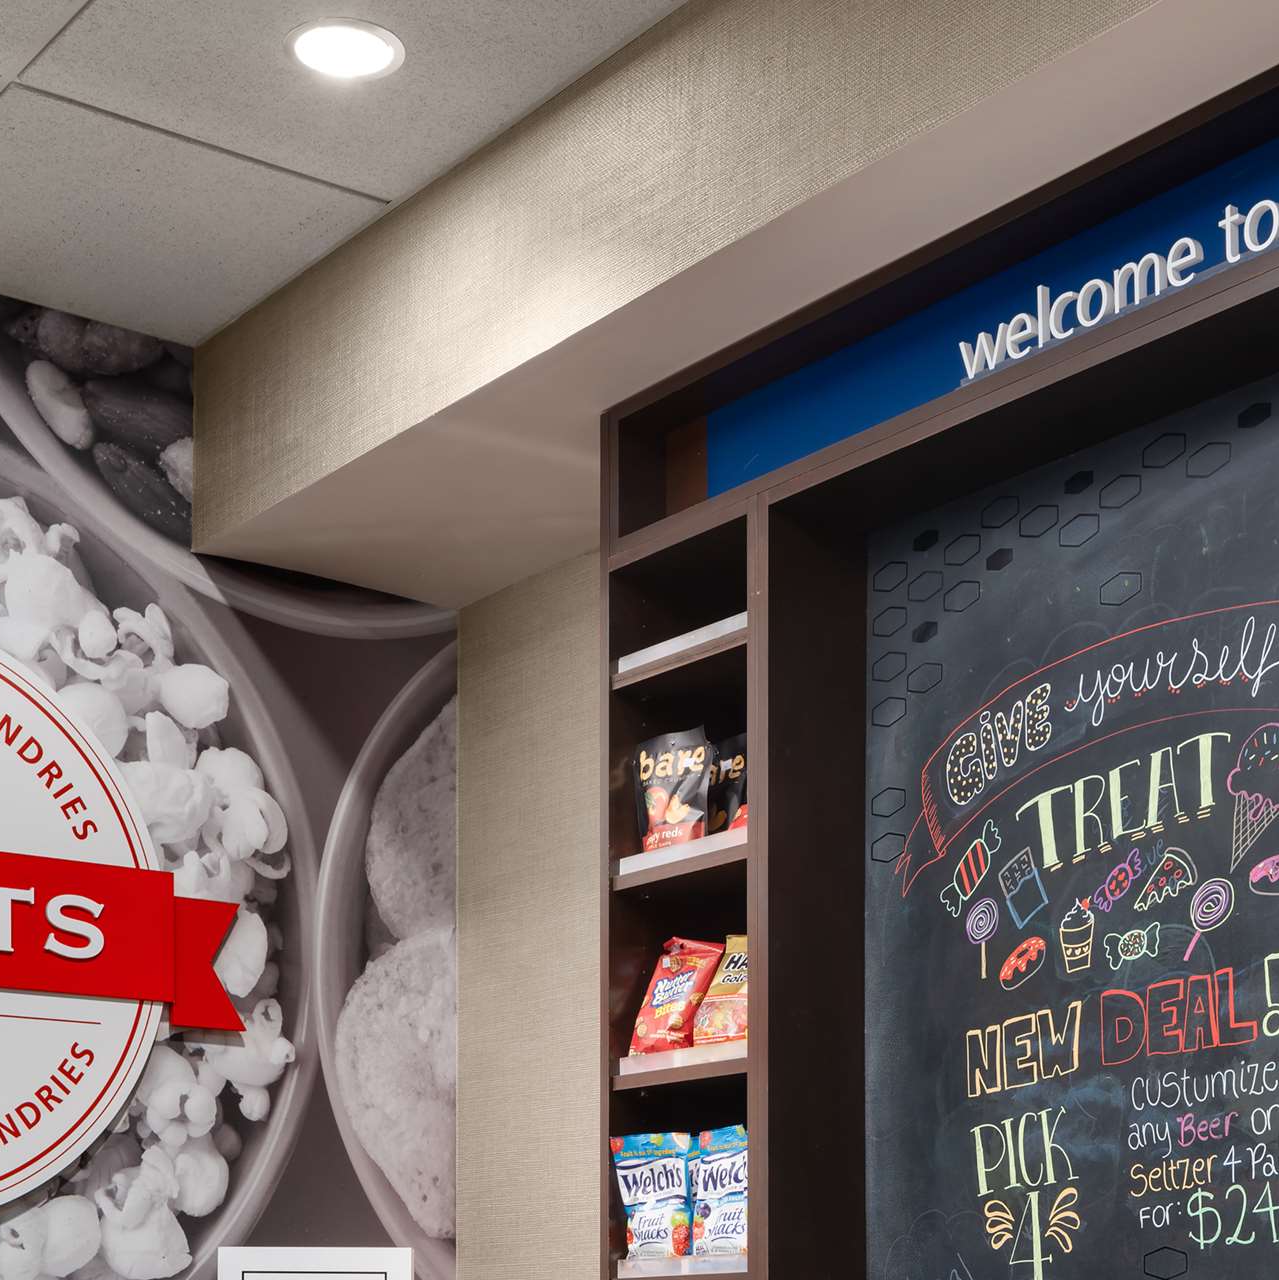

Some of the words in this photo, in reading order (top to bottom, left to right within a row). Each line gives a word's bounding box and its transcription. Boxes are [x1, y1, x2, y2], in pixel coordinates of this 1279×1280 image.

[958, 237, 1203, 379] welcome
[639, 746, 705, 781] bare
[1015, 732, 1232, 870] TREAT
[662, 827, 683, 839] reds
[966, 1000, 1083, 1098] NEW
[970, 1106, 1079, 1197] PICK
[1128, 1122, 1172, 1158] any
[1176, 1113, 1238, 1147] Beer
[1251, 1104, 1279, 1135] or
[621, 1158, 683, 1199] Welch's
[1130, 1154, 1218, 1197] Seltzer
[1223, 1145, 1241, 1183] 4
[633, 1226, 668, 1244] Snacks
[638, 1212, 664, 1229] Fruit
